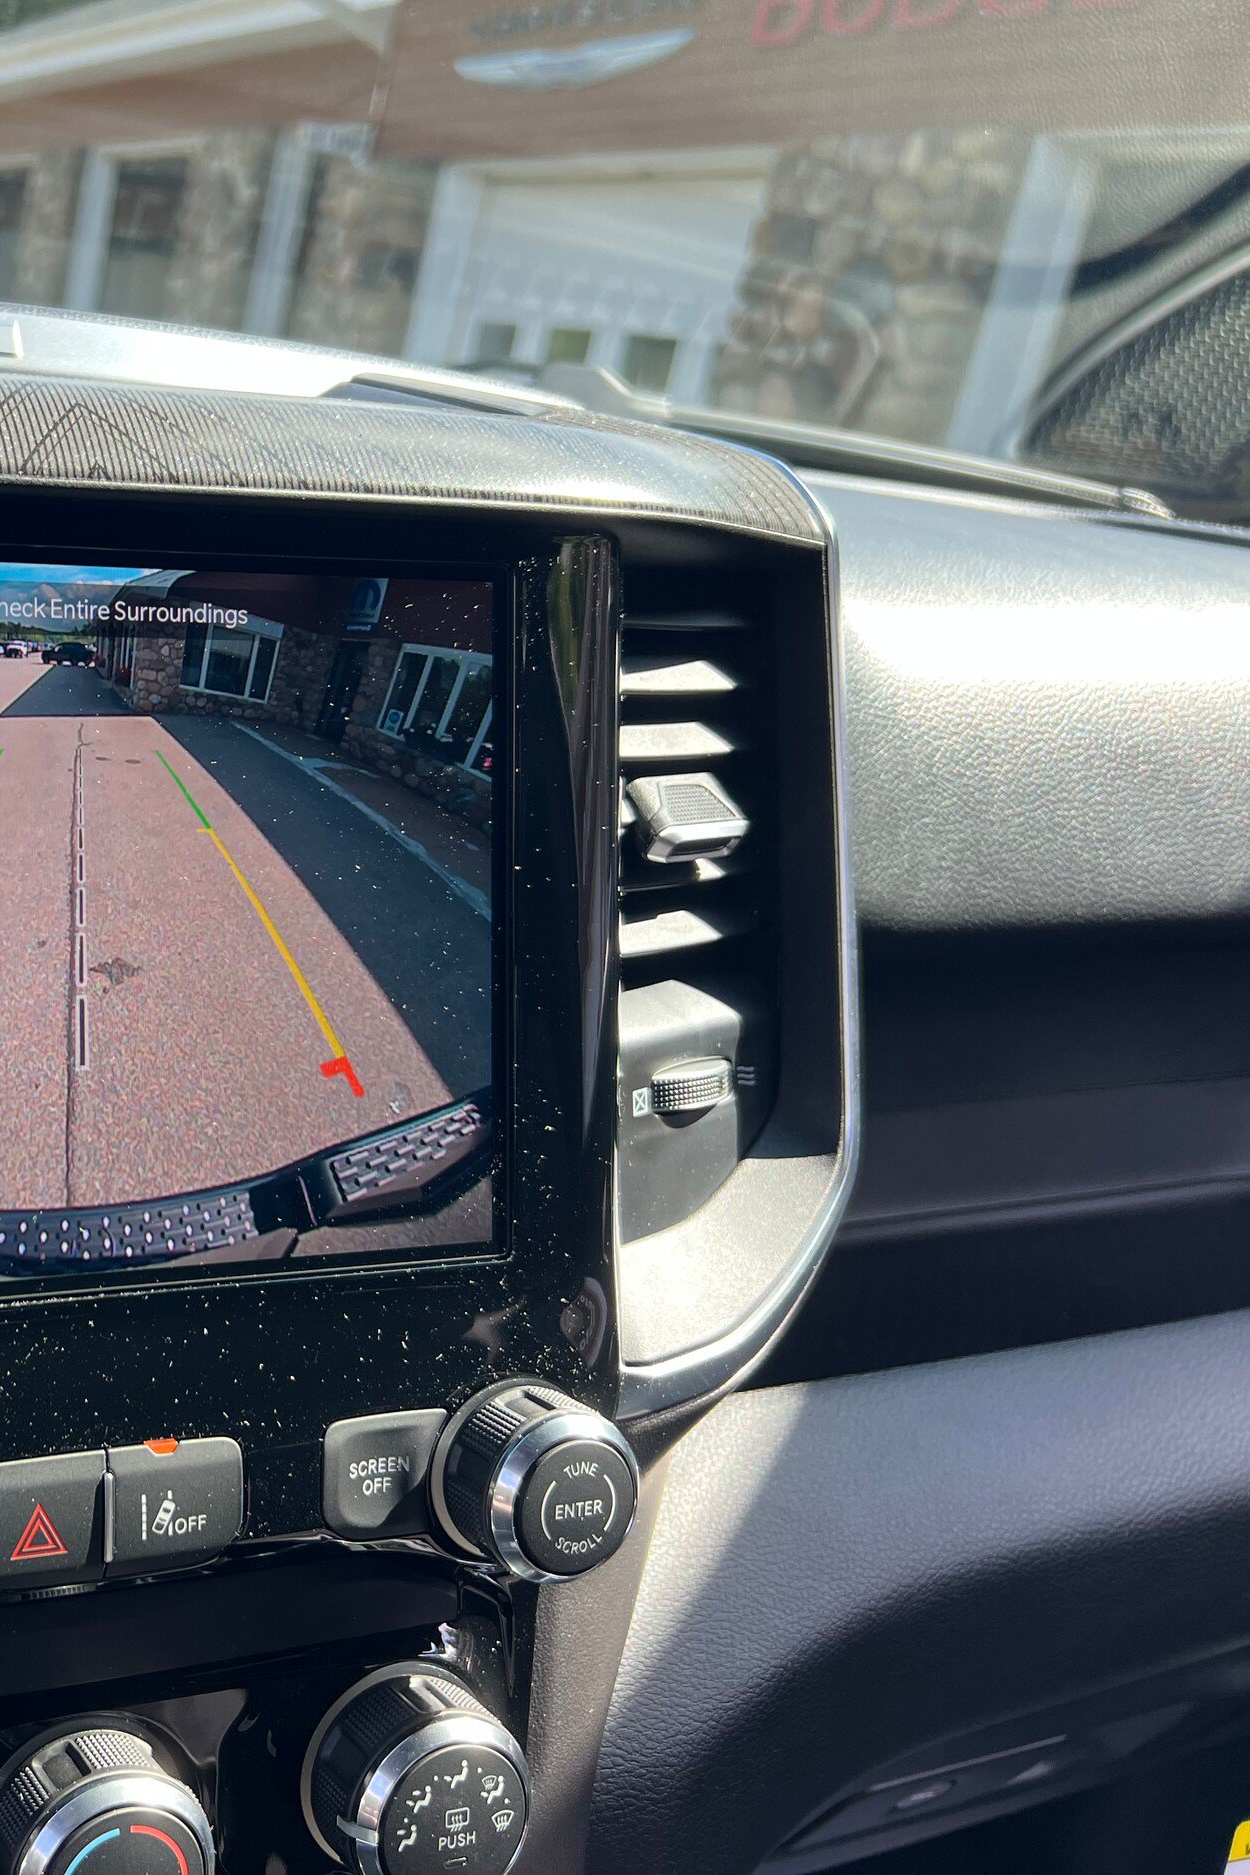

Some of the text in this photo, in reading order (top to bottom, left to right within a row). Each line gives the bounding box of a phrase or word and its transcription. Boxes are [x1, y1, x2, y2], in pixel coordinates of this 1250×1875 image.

[50, 598, 110, 621] Entire
[113, 601, 249, 629] Surroundings
[349, 1456, 410, 1479] SCREEN
[562, 1460, 600, 1480] TUNE
[362, 1477, 392, 1496] OFF
[554, 1499, 603, 1521] ENTER
[174, 1513, 208, 1535] OFF
[554, 1533, 603, 1555] SCROLL
[437, 1830, 477, 1852] PUSH
